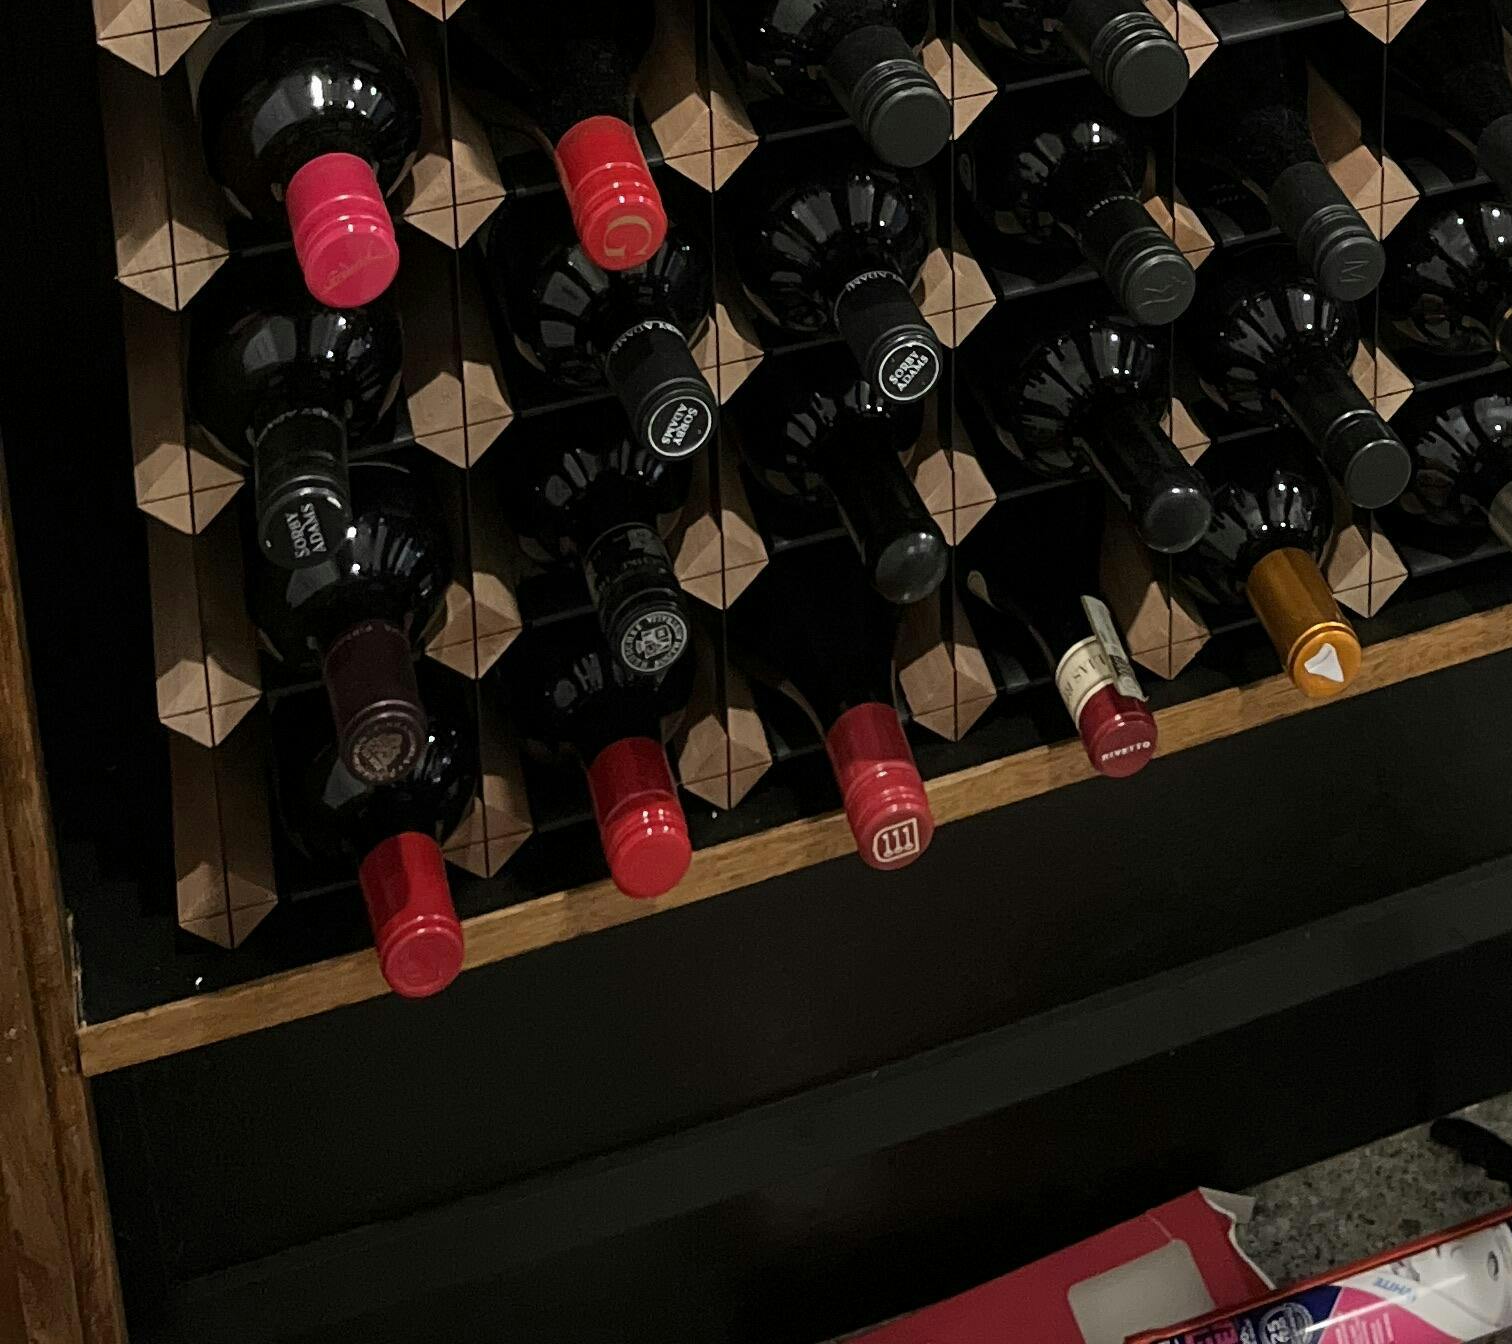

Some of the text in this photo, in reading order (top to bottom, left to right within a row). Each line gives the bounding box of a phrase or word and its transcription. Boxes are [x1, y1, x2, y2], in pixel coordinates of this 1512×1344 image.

[888, 351, 920, 385] SORBY
[896, 354, 929, 393] ADAMS
[661, 402, 688, 445] ADAMS
[672, 407, 699, 447] SORBY
[285, 512, 311, 559] SORBY
[300, 502, 328, 553] ADAMS
[1101, 741, 1151, 762] RIVETTO
